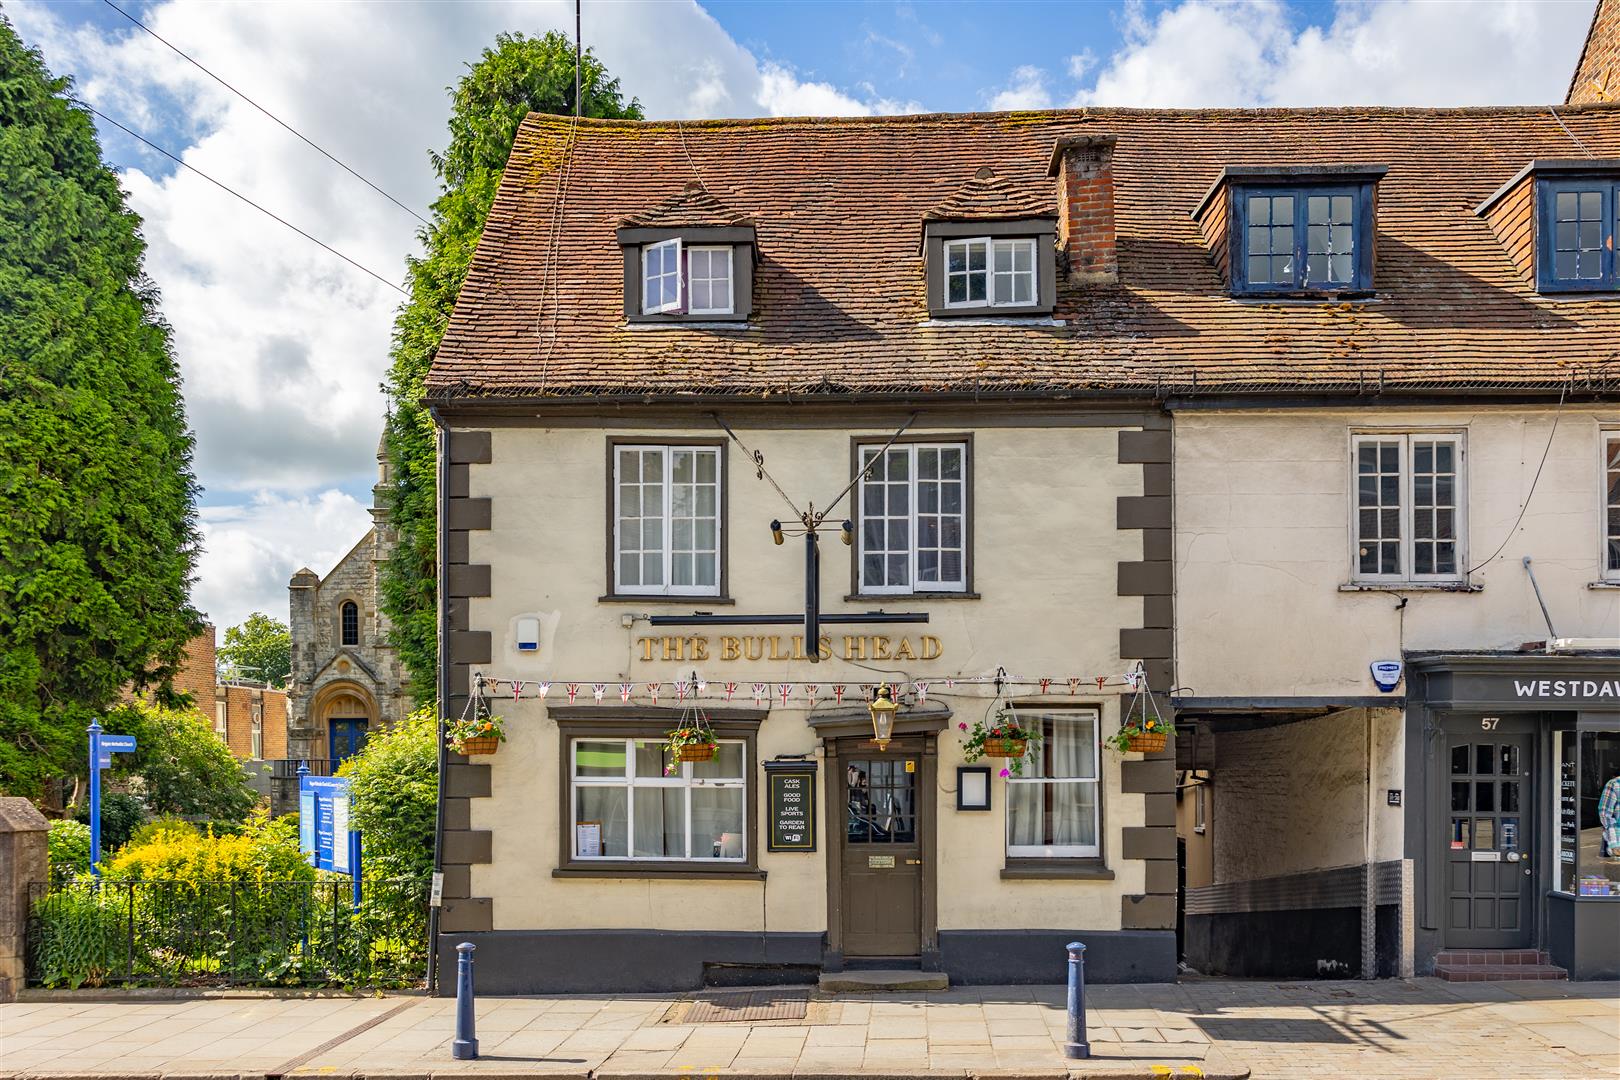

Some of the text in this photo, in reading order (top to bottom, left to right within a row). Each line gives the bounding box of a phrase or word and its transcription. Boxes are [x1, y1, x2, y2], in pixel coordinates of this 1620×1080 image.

[637, 637, 709, 661] THE
[843, 636, 944, 660] HEAD
[1514, 680, 1620, 697] WESTDA
[1481, 718, 1500, 730] 57
